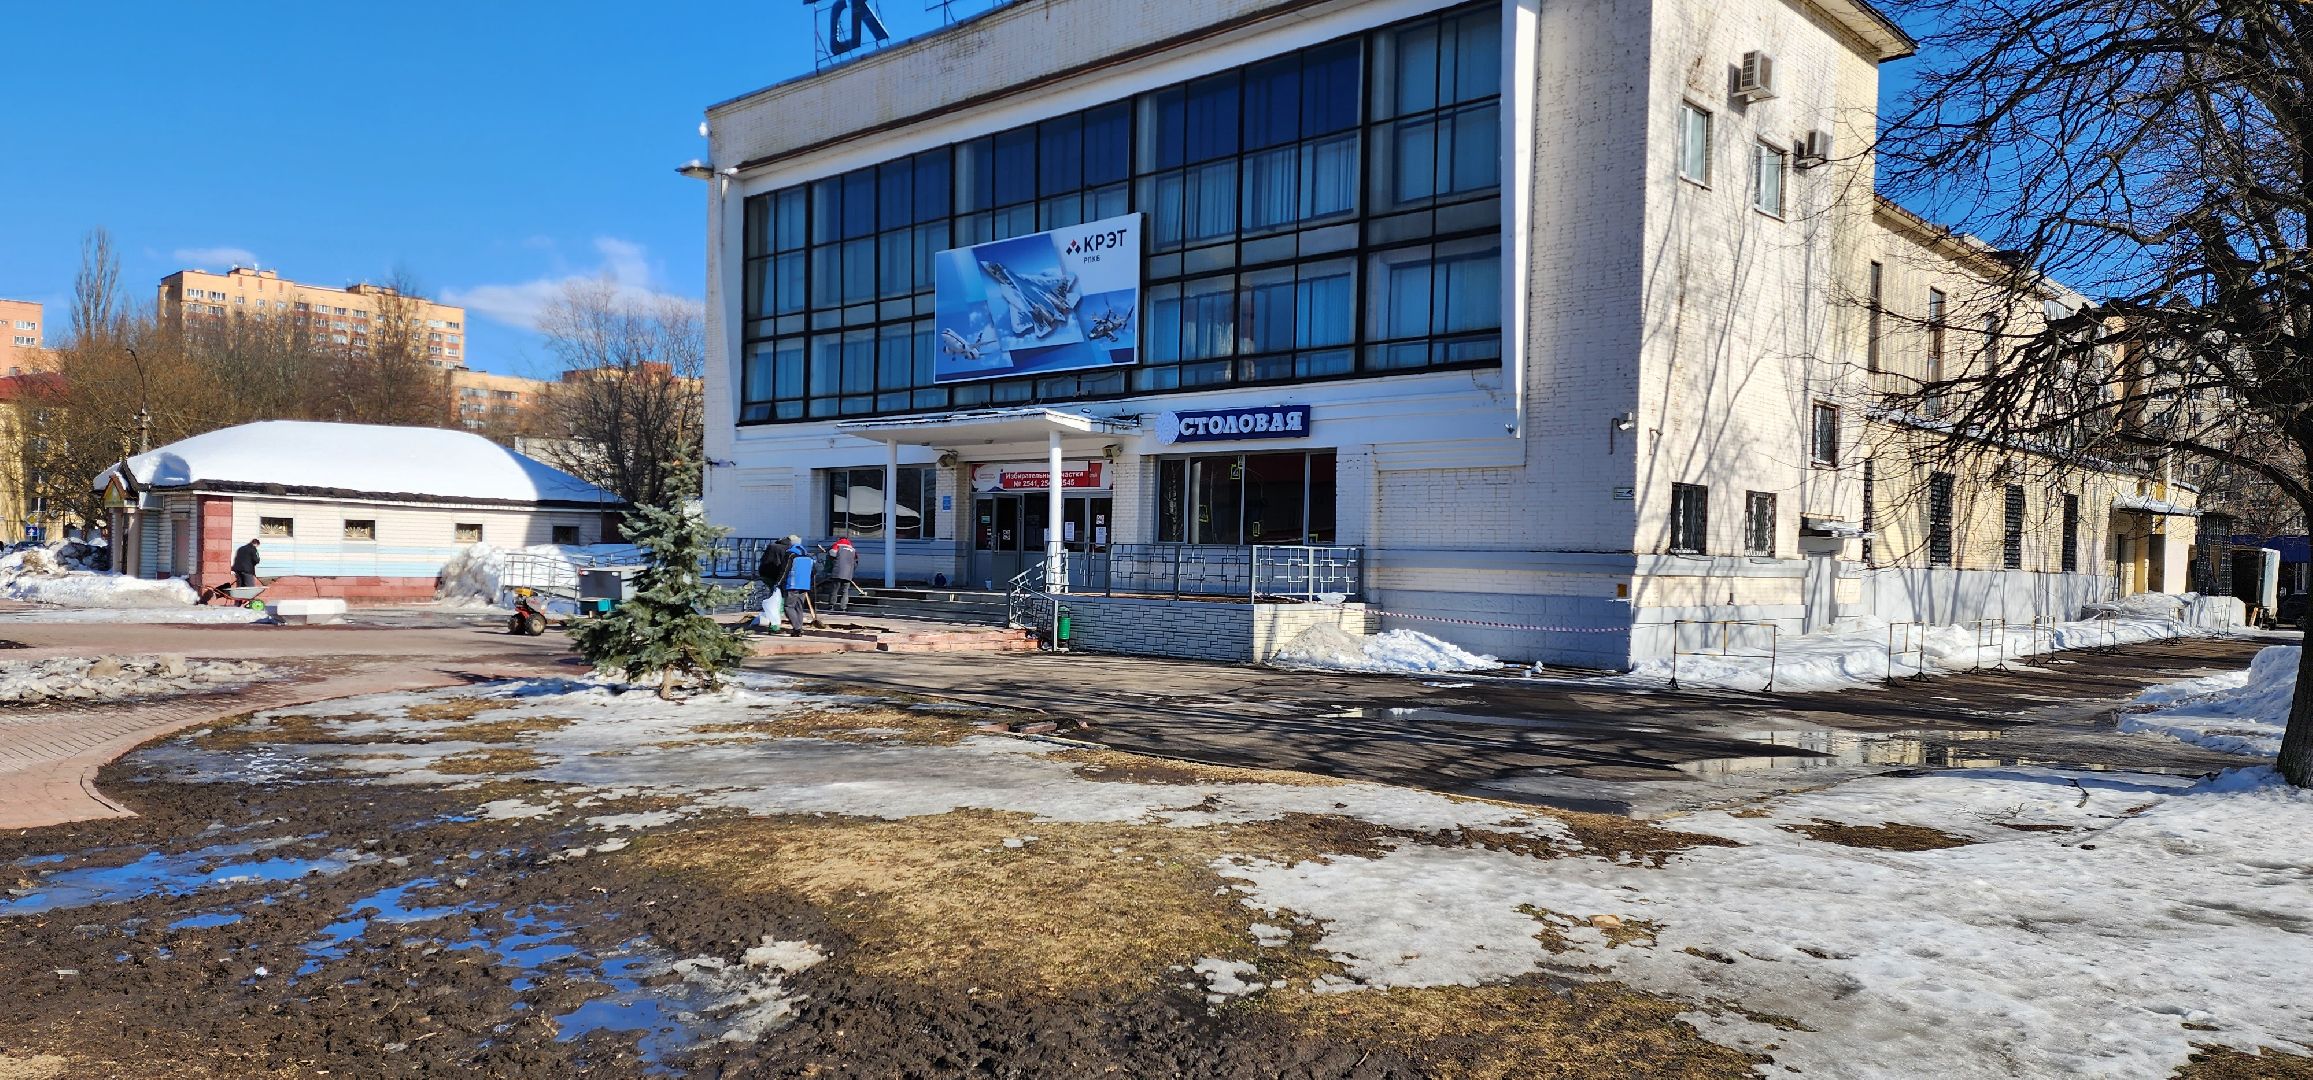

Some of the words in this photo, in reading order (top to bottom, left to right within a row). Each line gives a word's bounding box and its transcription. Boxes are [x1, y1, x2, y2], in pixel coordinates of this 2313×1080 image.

[1084, 229, 1127, 253] КРЭТ
[1180, 412, 1302, 436] СТОЛОВАЯ
[1005, 471, 1050, 480] Избирательн
[1060, 471, 1084, 479] частки
